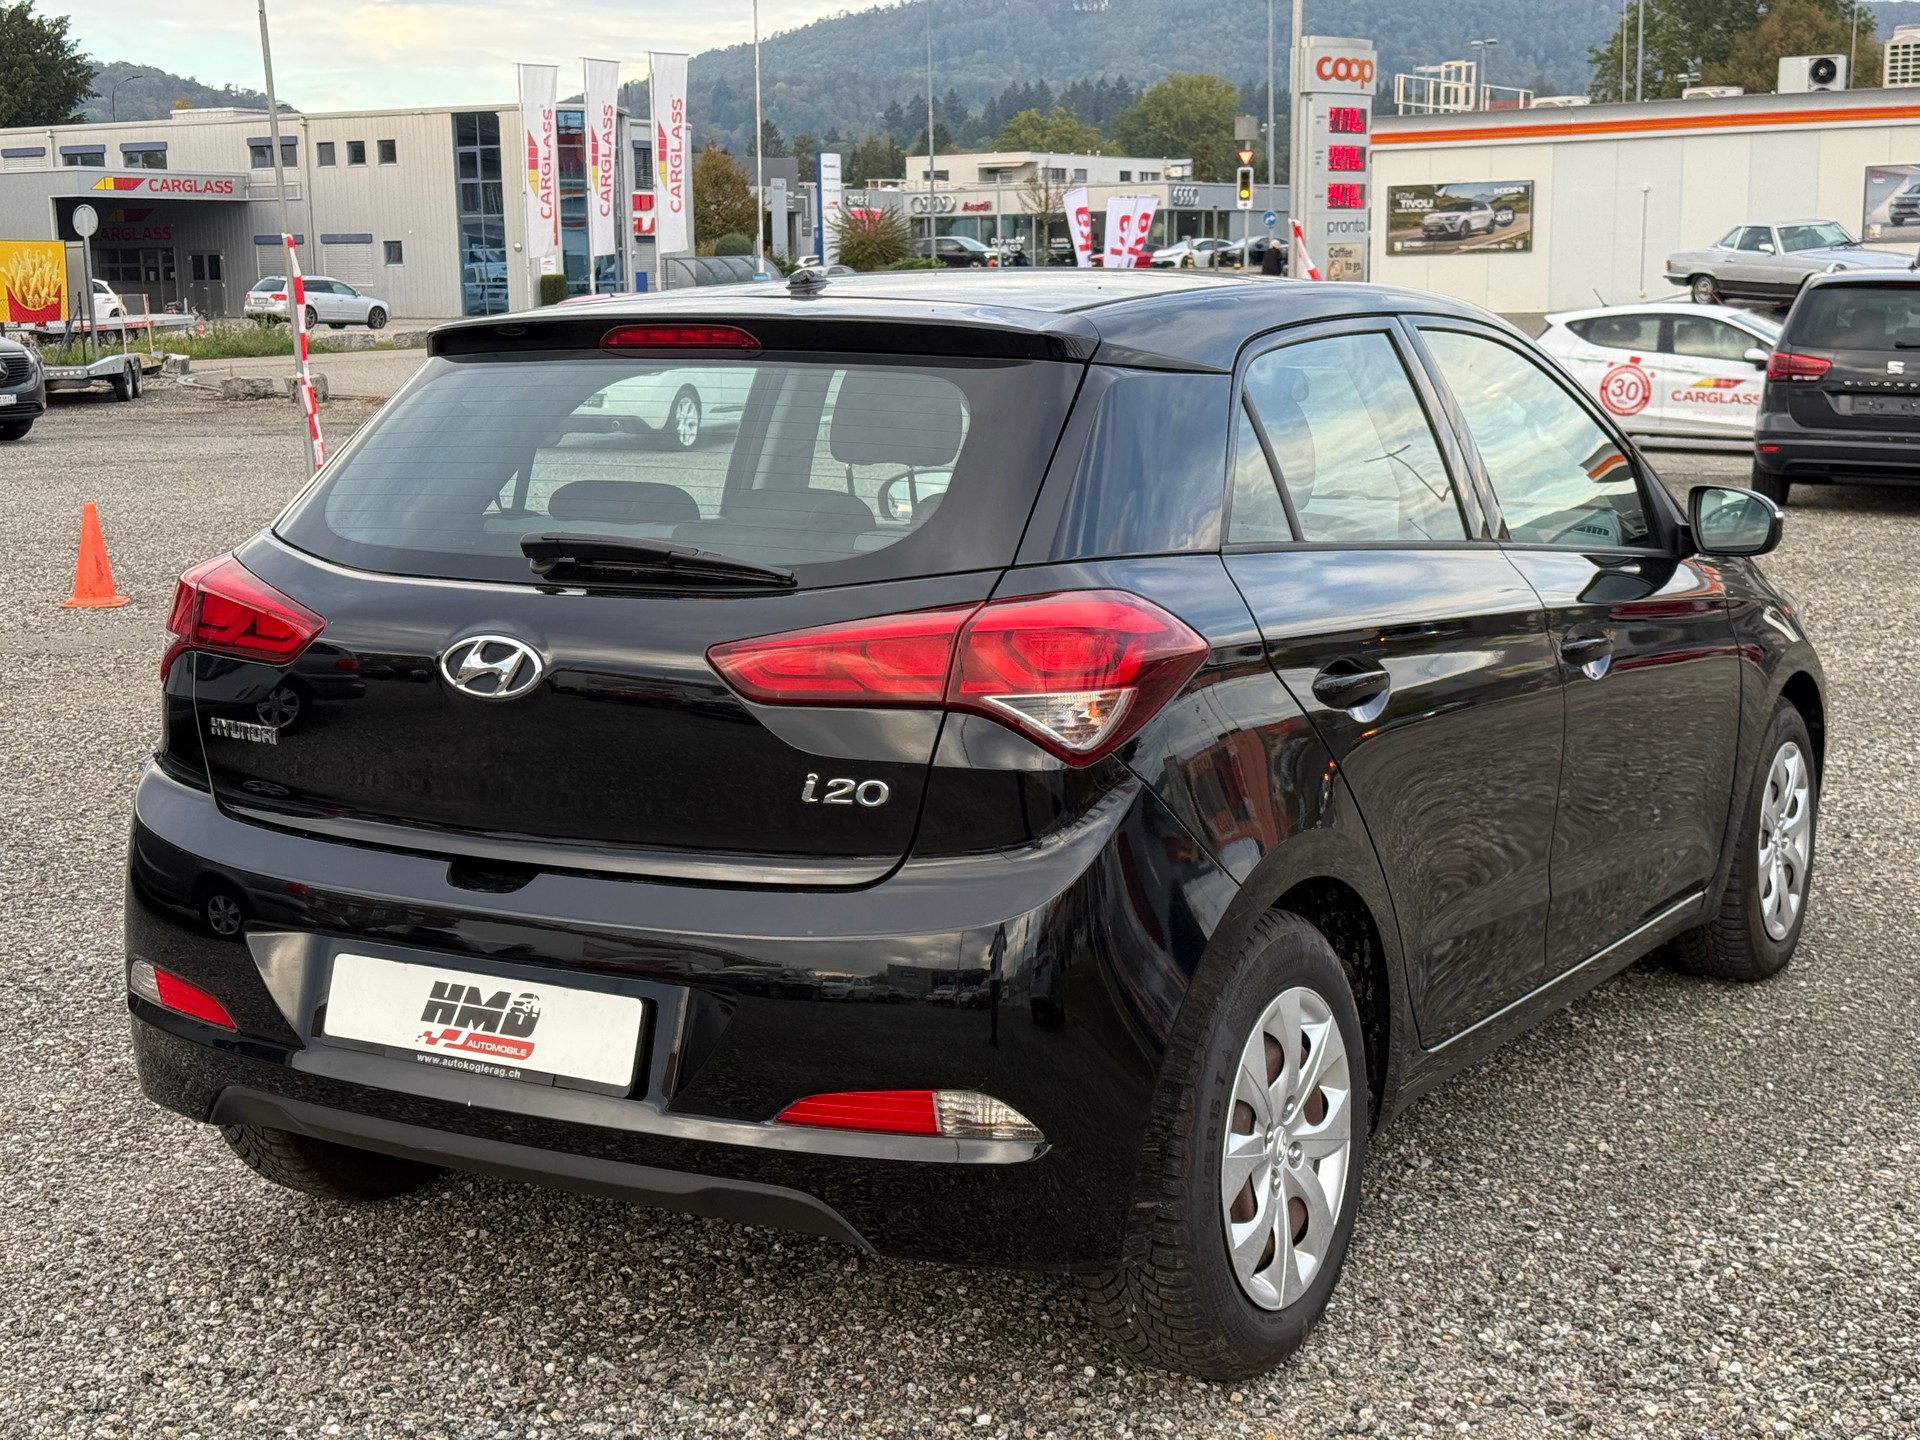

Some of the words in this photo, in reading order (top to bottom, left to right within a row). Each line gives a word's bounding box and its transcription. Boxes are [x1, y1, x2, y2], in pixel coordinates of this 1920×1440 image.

[1316, 56, 1374, 89] coop
[540, 108, 553, 219] CARGLASS
[600, 104, 614, 217] CARGLASS
[671, 98, 683, 213] CARGLASS
[148, 178, 234, 194] CARGLASS
[1327, 218, 1366, 236] pronto
[1328, 248, 1353, 258] Coffee
[1611, 378, 1639, 400] 30
[210, 717, 278, 746] HYUNDAI
[801, 773, 889, 807] i20
[467, 1040, 527, 1057] AUTOMOBILE
[417, 1054, 521, 1080] www.autokoglerag.ch
